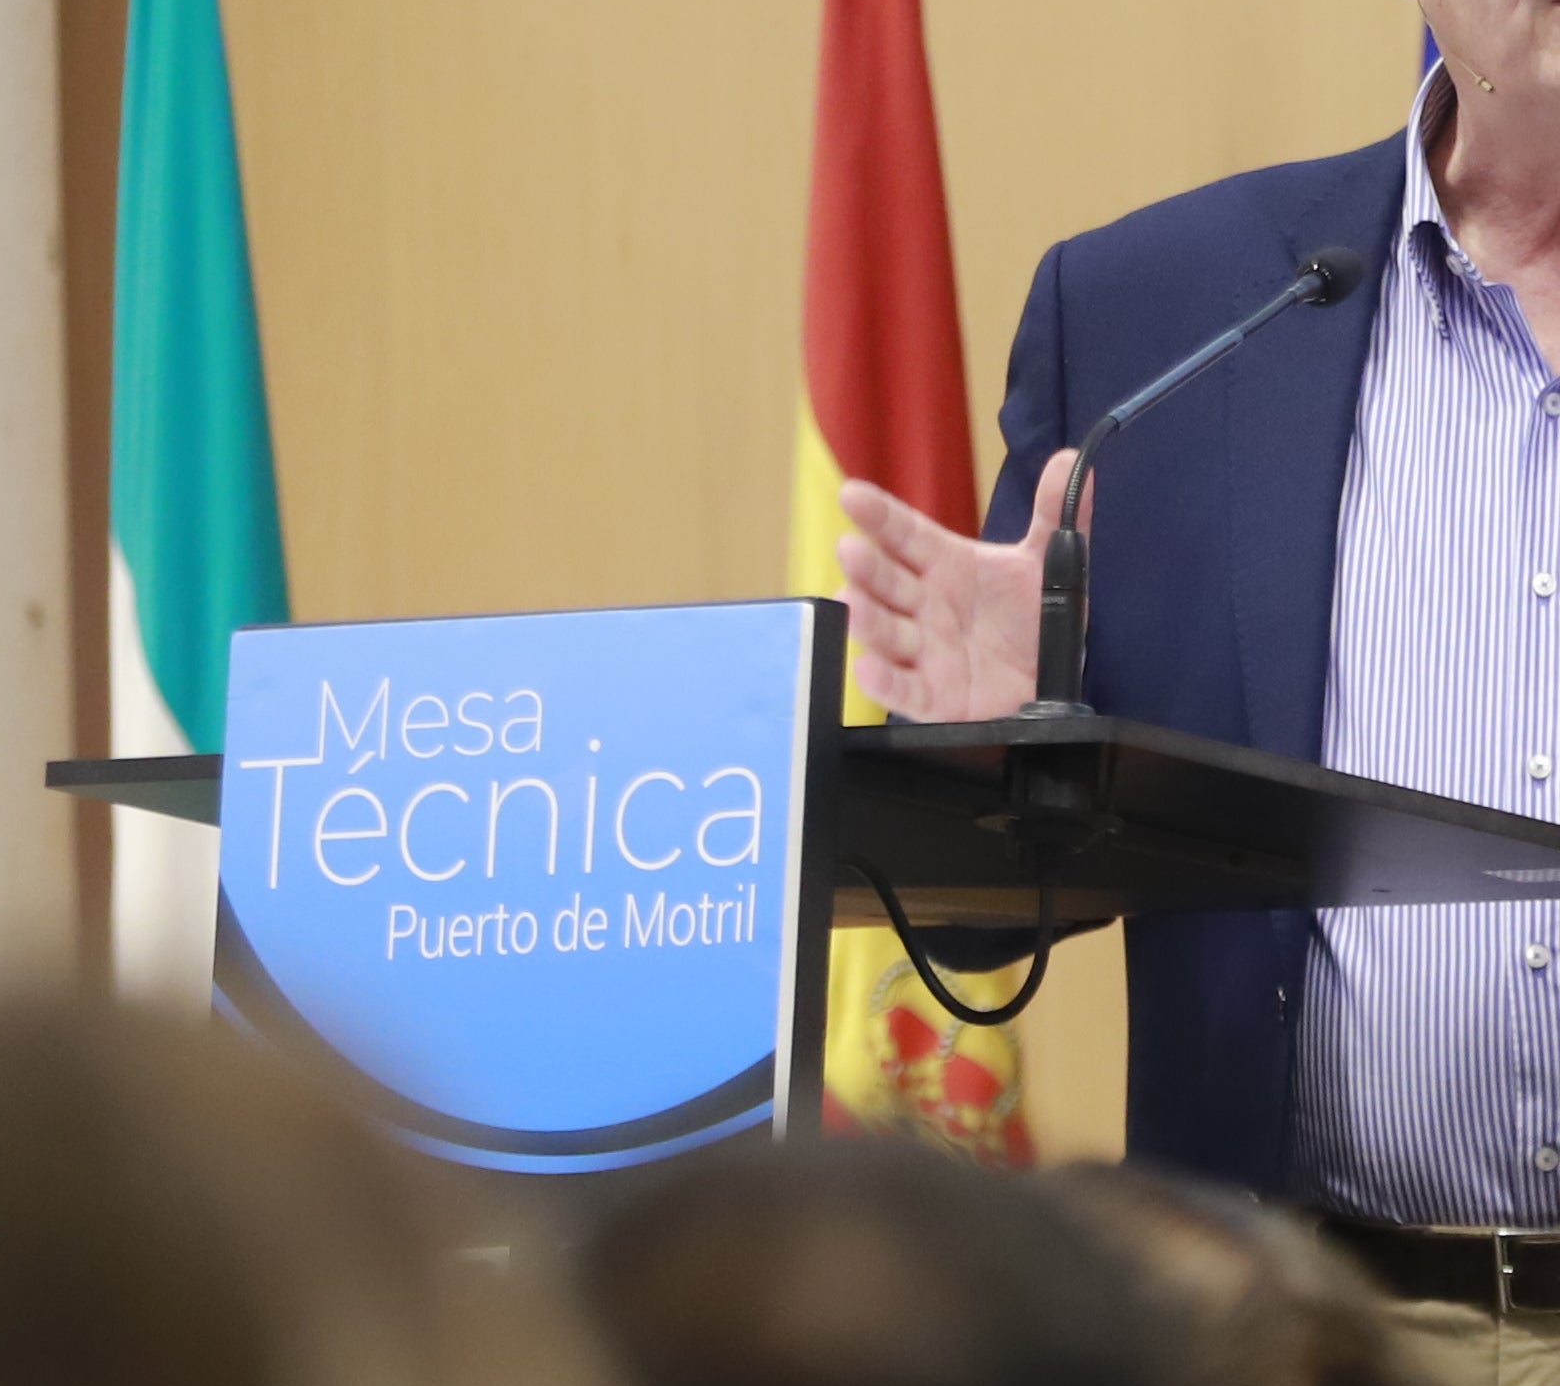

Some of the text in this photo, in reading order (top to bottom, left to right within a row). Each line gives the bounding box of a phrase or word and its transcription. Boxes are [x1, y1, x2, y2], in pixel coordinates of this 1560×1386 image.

[317, 676, 543, 764] Mesa
[240, 738, 763, 890] Técnica
[386, 884, 757, 960] Puerto de Motril
